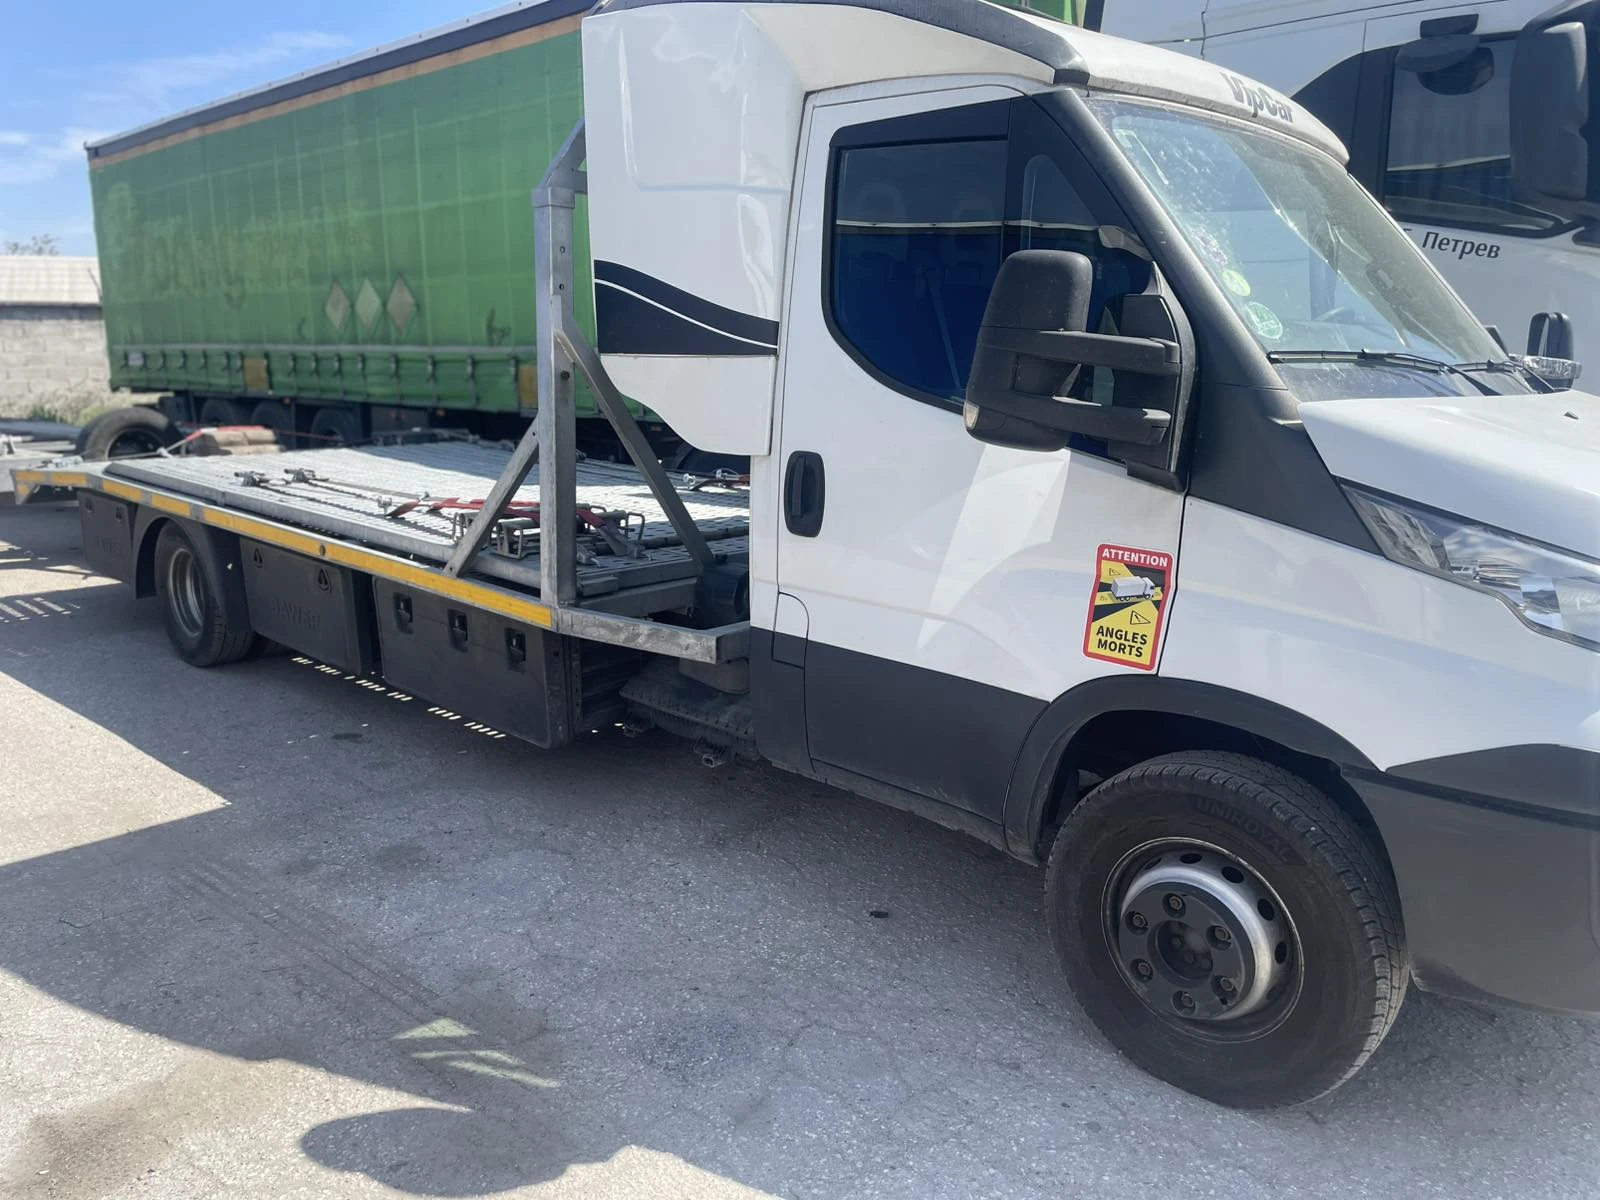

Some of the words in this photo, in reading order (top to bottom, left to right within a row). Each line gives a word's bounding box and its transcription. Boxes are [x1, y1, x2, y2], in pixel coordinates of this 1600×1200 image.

[1219, 71, 1294, 123] VipCar
[1422, 231, 1501, 260] Петрев
[1102, 548, 1168, 567] ATTENTION
[1096, 625, 1148, 645] ANGLES
[1097, 638, 1143, 657] MORTS
